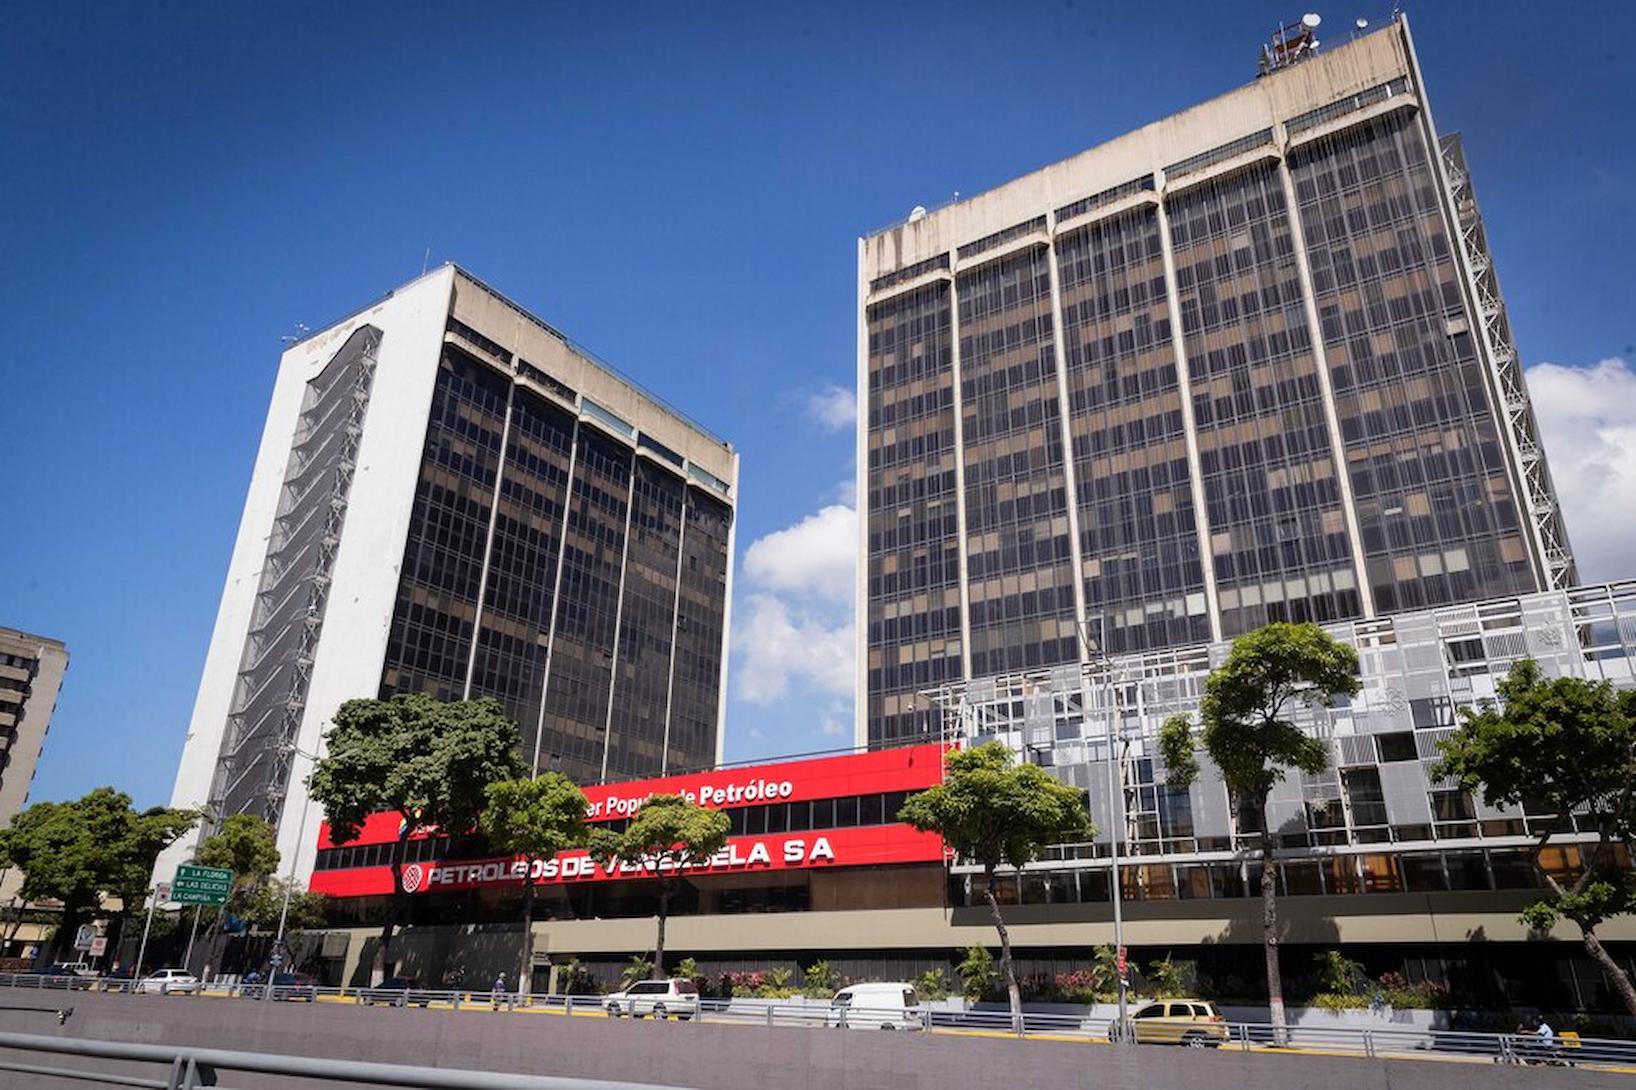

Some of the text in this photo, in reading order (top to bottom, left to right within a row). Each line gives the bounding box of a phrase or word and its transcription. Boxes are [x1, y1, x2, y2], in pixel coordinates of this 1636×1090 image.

[606, 792, 654, 817] Popu
[700, 778, 793, 805] Petróleo
[192, 869, 201, 877] LA
[428, 858, 558, 885] PETROLEOS
[561, 856, 595, 874] DE
[186, 880, 199, 888] LAS
[173, 892, 182, 900] LA
